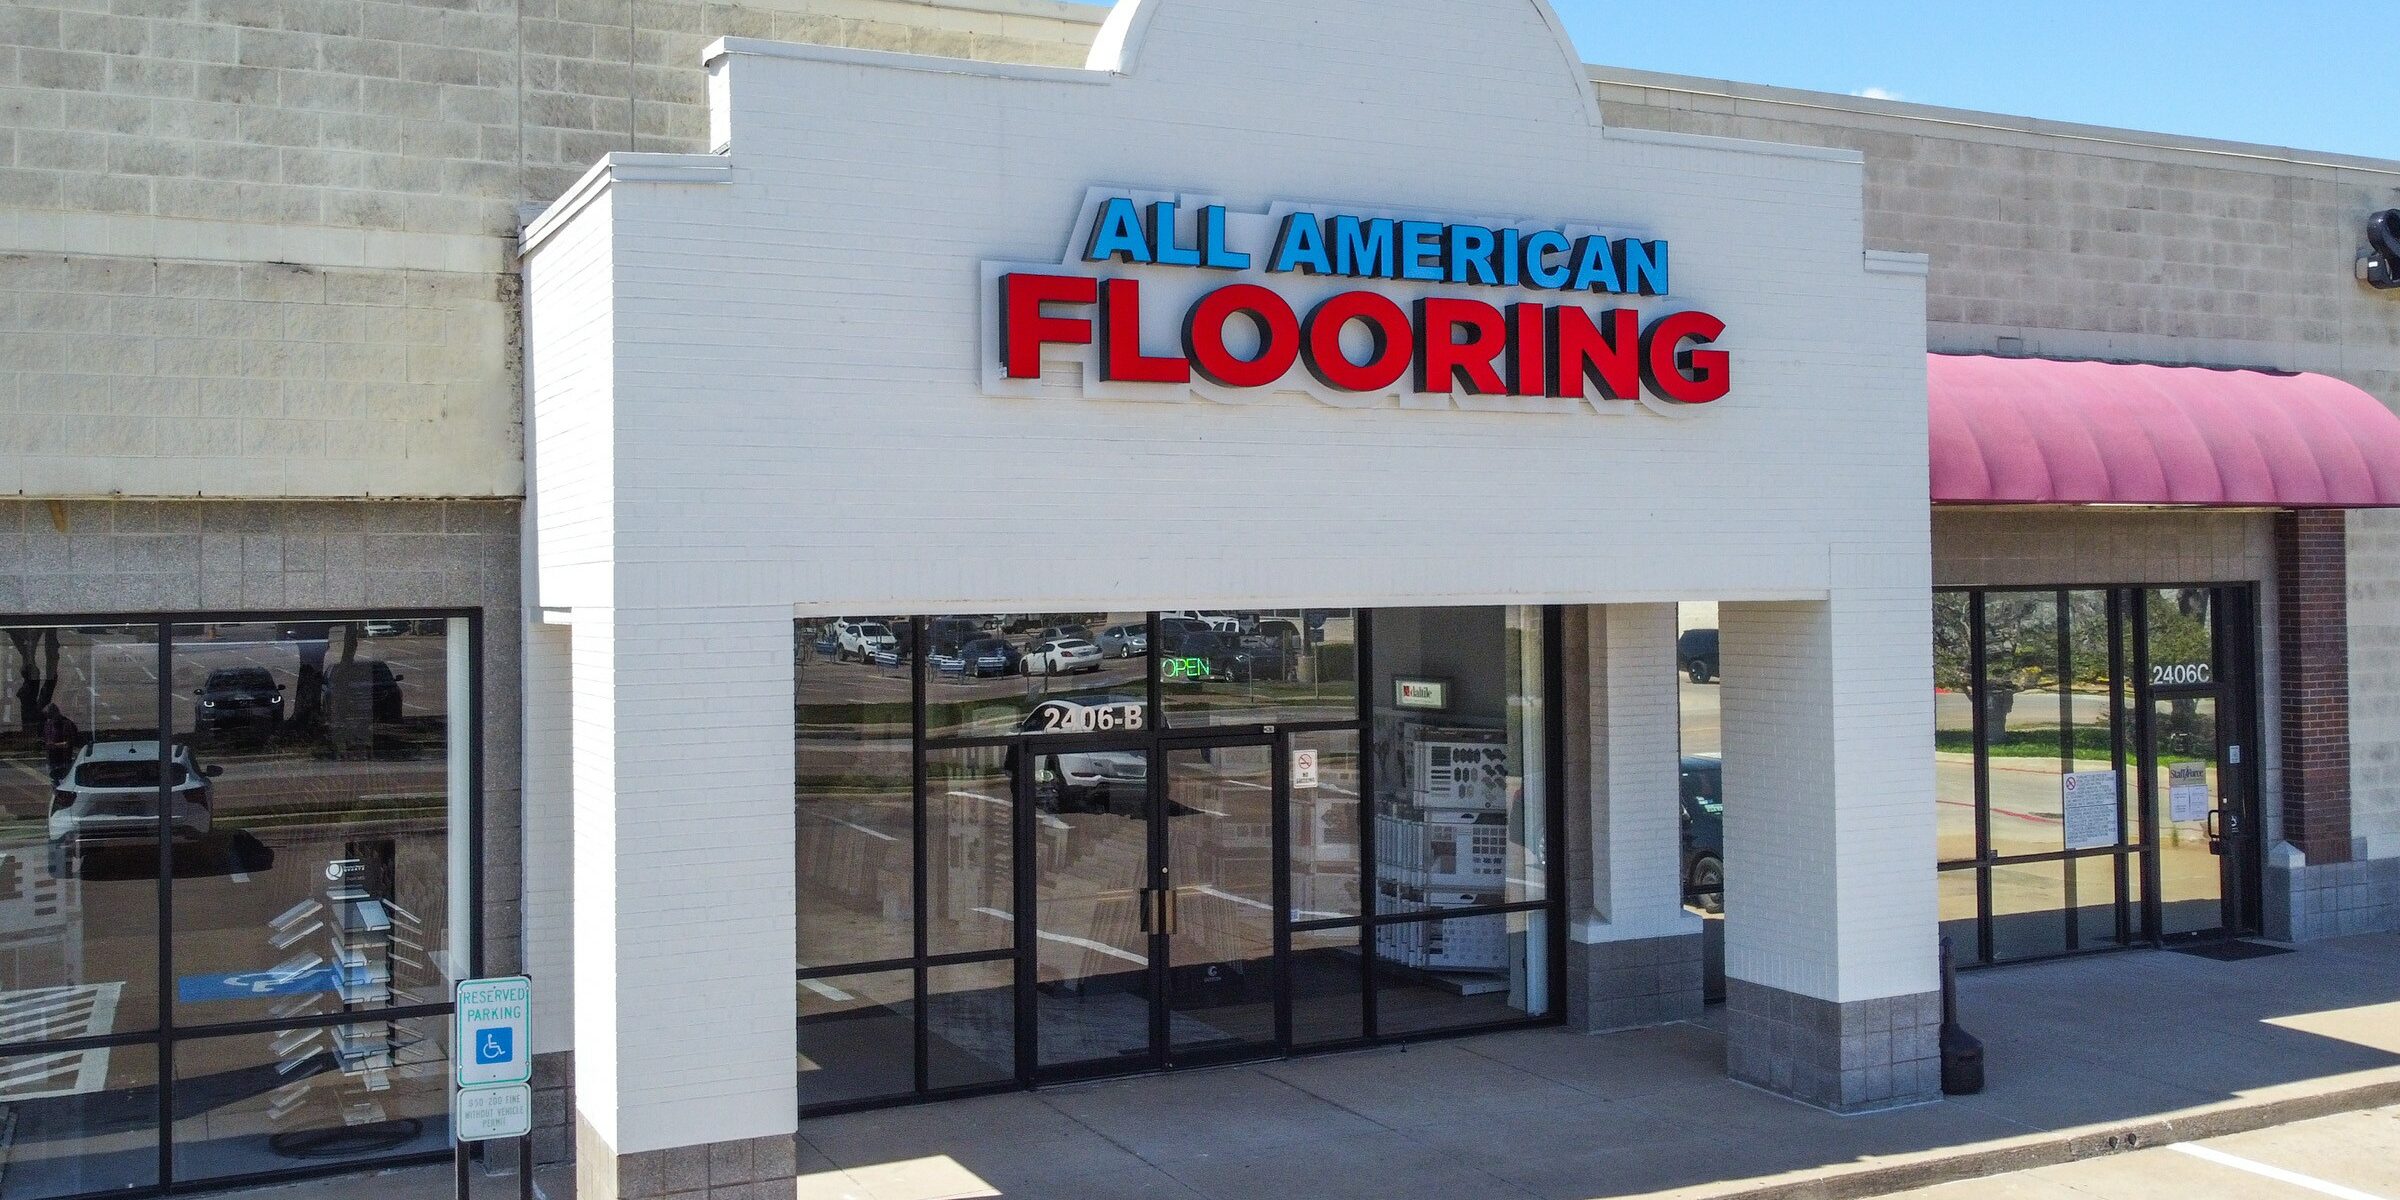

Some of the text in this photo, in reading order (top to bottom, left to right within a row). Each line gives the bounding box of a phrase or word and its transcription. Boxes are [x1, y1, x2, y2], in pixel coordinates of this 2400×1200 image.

[1084, 198, 1669, 296] ALL AMERICAN
[1001, 273, 1730, 404] FLOORING
[1162, 657, 1210, 677] OPEN
[2153, 663, 2209, 685] 2406C
[1044, 705, 1143, 734] 2406-B
[463, 988, 526, 1004] RESERVED
[467, 1006, 521, 1022] PARKING
[505, 1094, 521, 1104] FINE
[465, 1105, 524, 1120] WITHOUT VEHICLE
[482, 1117, 507, 1129] PERMIT
